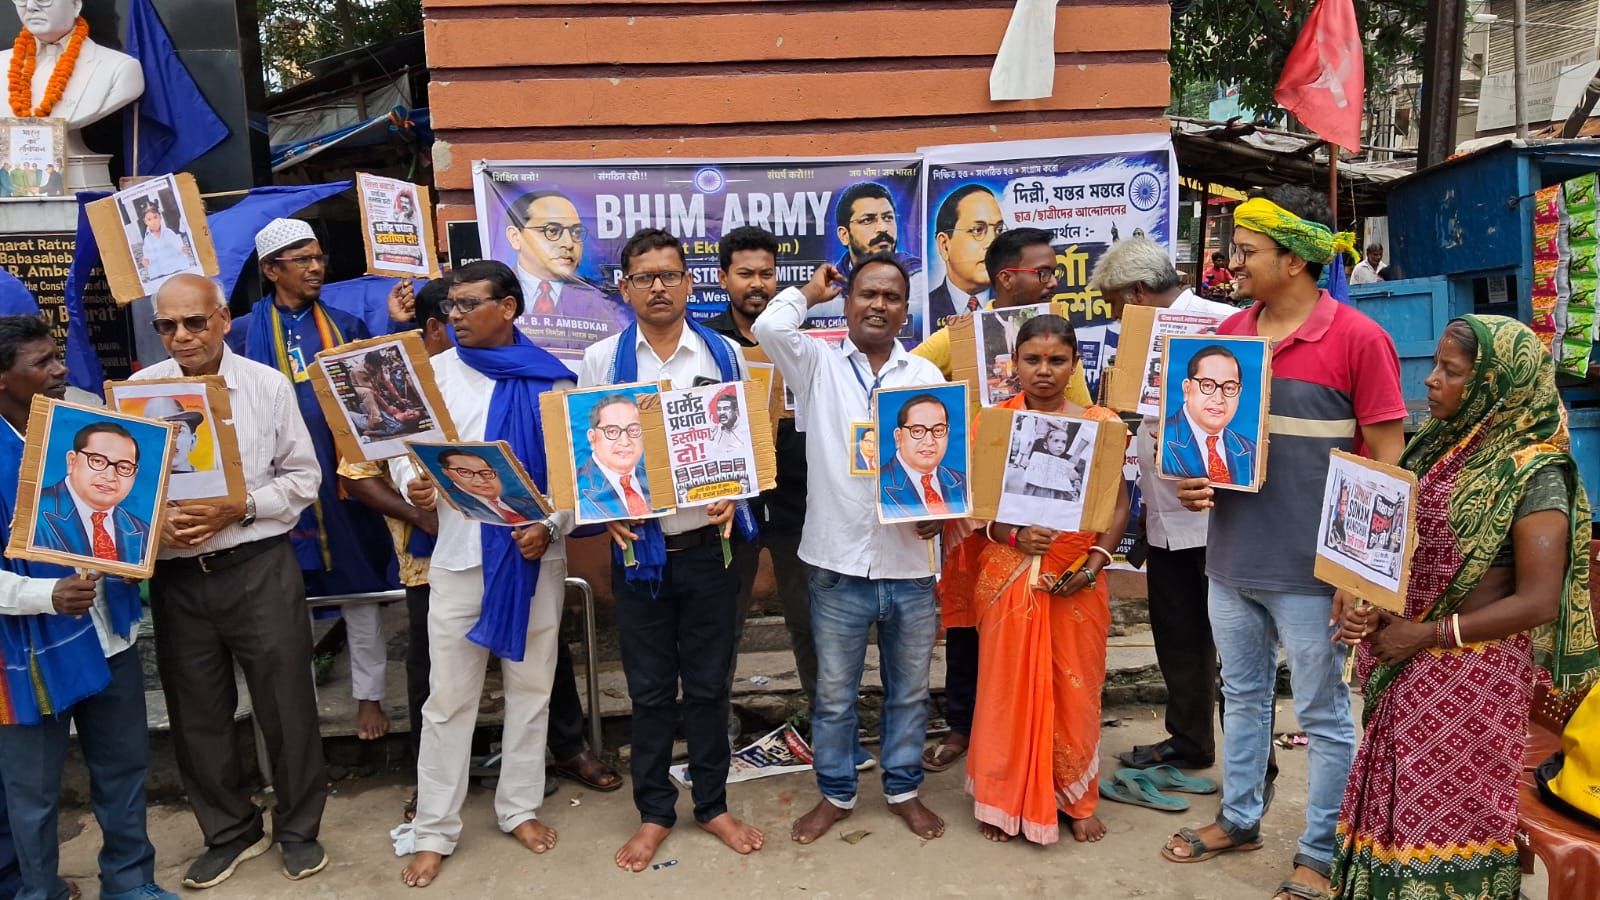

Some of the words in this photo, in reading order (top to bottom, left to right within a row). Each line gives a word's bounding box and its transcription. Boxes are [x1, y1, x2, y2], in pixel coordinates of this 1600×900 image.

[596, 193, 705, 239] BHIM
[720, 190, 832, 237] ARMY
[0, 252, 73, 264] Babasaheb
[556, 320, 608, 332] AMBEDKAR
[668, 411, 707, 432] प्रधान
[670, 427, 712, 447] इस्तीफा
[674, 443, 707, 463] दो!
